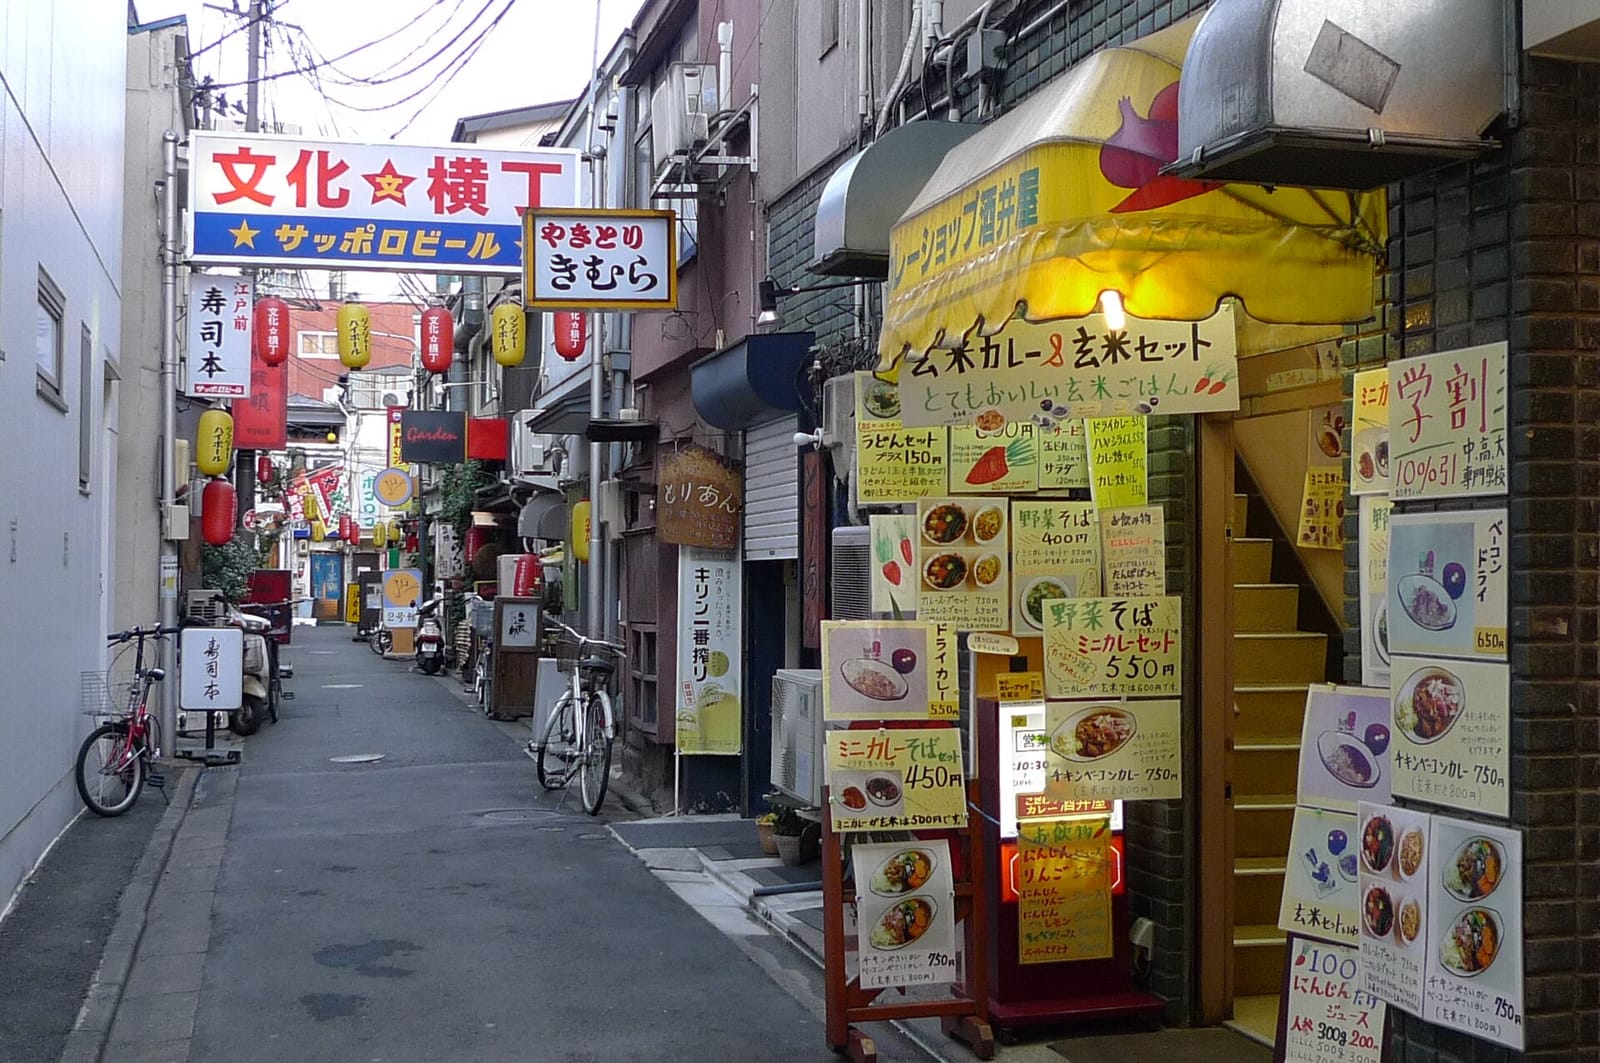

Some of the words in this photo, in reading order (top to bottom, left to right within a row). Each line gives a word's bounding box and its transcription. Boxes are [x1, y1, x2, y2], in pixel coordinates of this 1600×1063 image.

[212, 146, 351, 209] 文化
[427, 155, 563, 217] 横丁
[274, 223, 501, 260] サッポロビール
[540, 221, 643, 250] やきとり
[549, 254, 658, 293] きむら
[234, 282, 249, 331] 江戸前
[198, 286, 227, 379] 寿司本
[349, 319, 361, 356] ハイボール
[923, 375, 1188, 413] とてもおいしい玄米ごはん
[1397, 358, 1488, 444] 学割
[406, 426, 458, 443] Garden
[862, 431, 938, 449] うどんセット
[1092, 419, 1129, 434] ドライカレー
[211, 426, 224, 463] ハイボール
[1461, 465, 1505, 490] 専門学校
[664, 482, 736, 513] とりあん
[1018, 508, 1093, 529] 野菜そば
[1042, 532, 1088, 546] 400円
[1489, 519, 1504, 575] ベーコン
[1477, 548, 1488, 602] ドライ
[692, 567, 711, 682] キリン一番搾り
[1050, 600, 1159, 632] 野菜そば
[1078, 630, 1175, 654] ミニカレーセット
[1477, 632, 1504, 650] 650円
[203, 636, 220, 700] 寿司本
[935, 622, 949, 701] ドライカレー
[1105, 655, 1175, 680] 550円
[930, 703, 959, 716] 550円
[904, 764, 962, 790] 450円
[1144, 768, 1179, 781] 750円
[1394, 750, 1469, 780] チキンベーコンカレー
[1473, 764, 1505, 788] 750円
[1024, 865, 1069, 884] りんご
[927, 952, 956, 967] 750円
[1293, 975, 1352, 1000] にんじん
[1325, 1003, 1370, 1029] ジュース
[1494, 996, 1523, 1027] 750円
[1316, 1021, 1347, 1047] 300g
